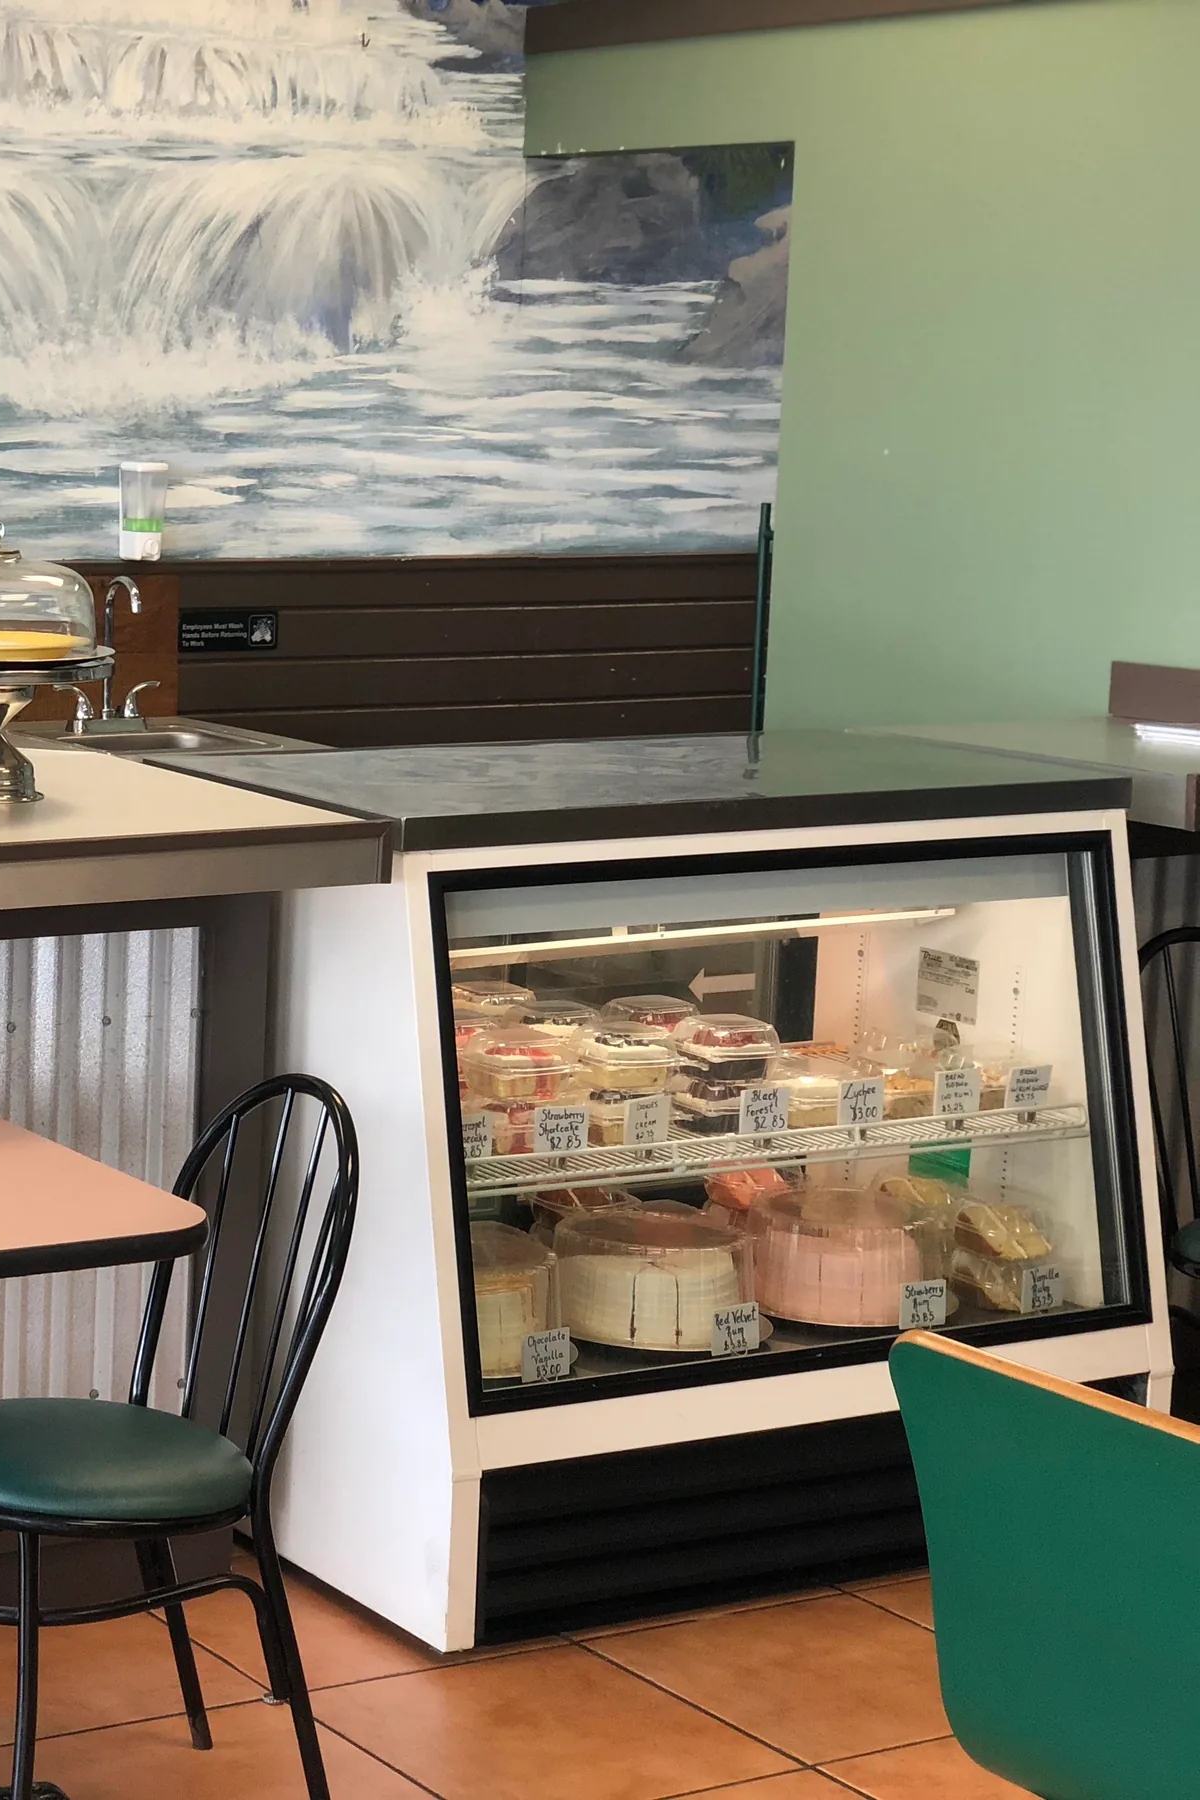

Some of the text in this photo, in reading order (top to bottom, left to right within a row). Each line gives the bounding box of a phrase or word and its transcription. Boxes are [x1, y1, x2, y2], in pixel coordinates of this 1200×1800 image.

[182, 631, 200, 639] Hands
[201, 630, 220, 638] Before
[751, 1088, 779, 1107] Black
[541, 1108, 585, 1124] Strawberry
[746, 1104, 775, 1117] Forest
[538, 1122, 580, 1141] Shortcake
[905, 1284, 944, 1299] Strawberry
[714, 1305, 757, 1331] Red Velvet
[527, 1331, 566, 1353] Chocolate
[531, 1349, 564, 1368] Vanilla
